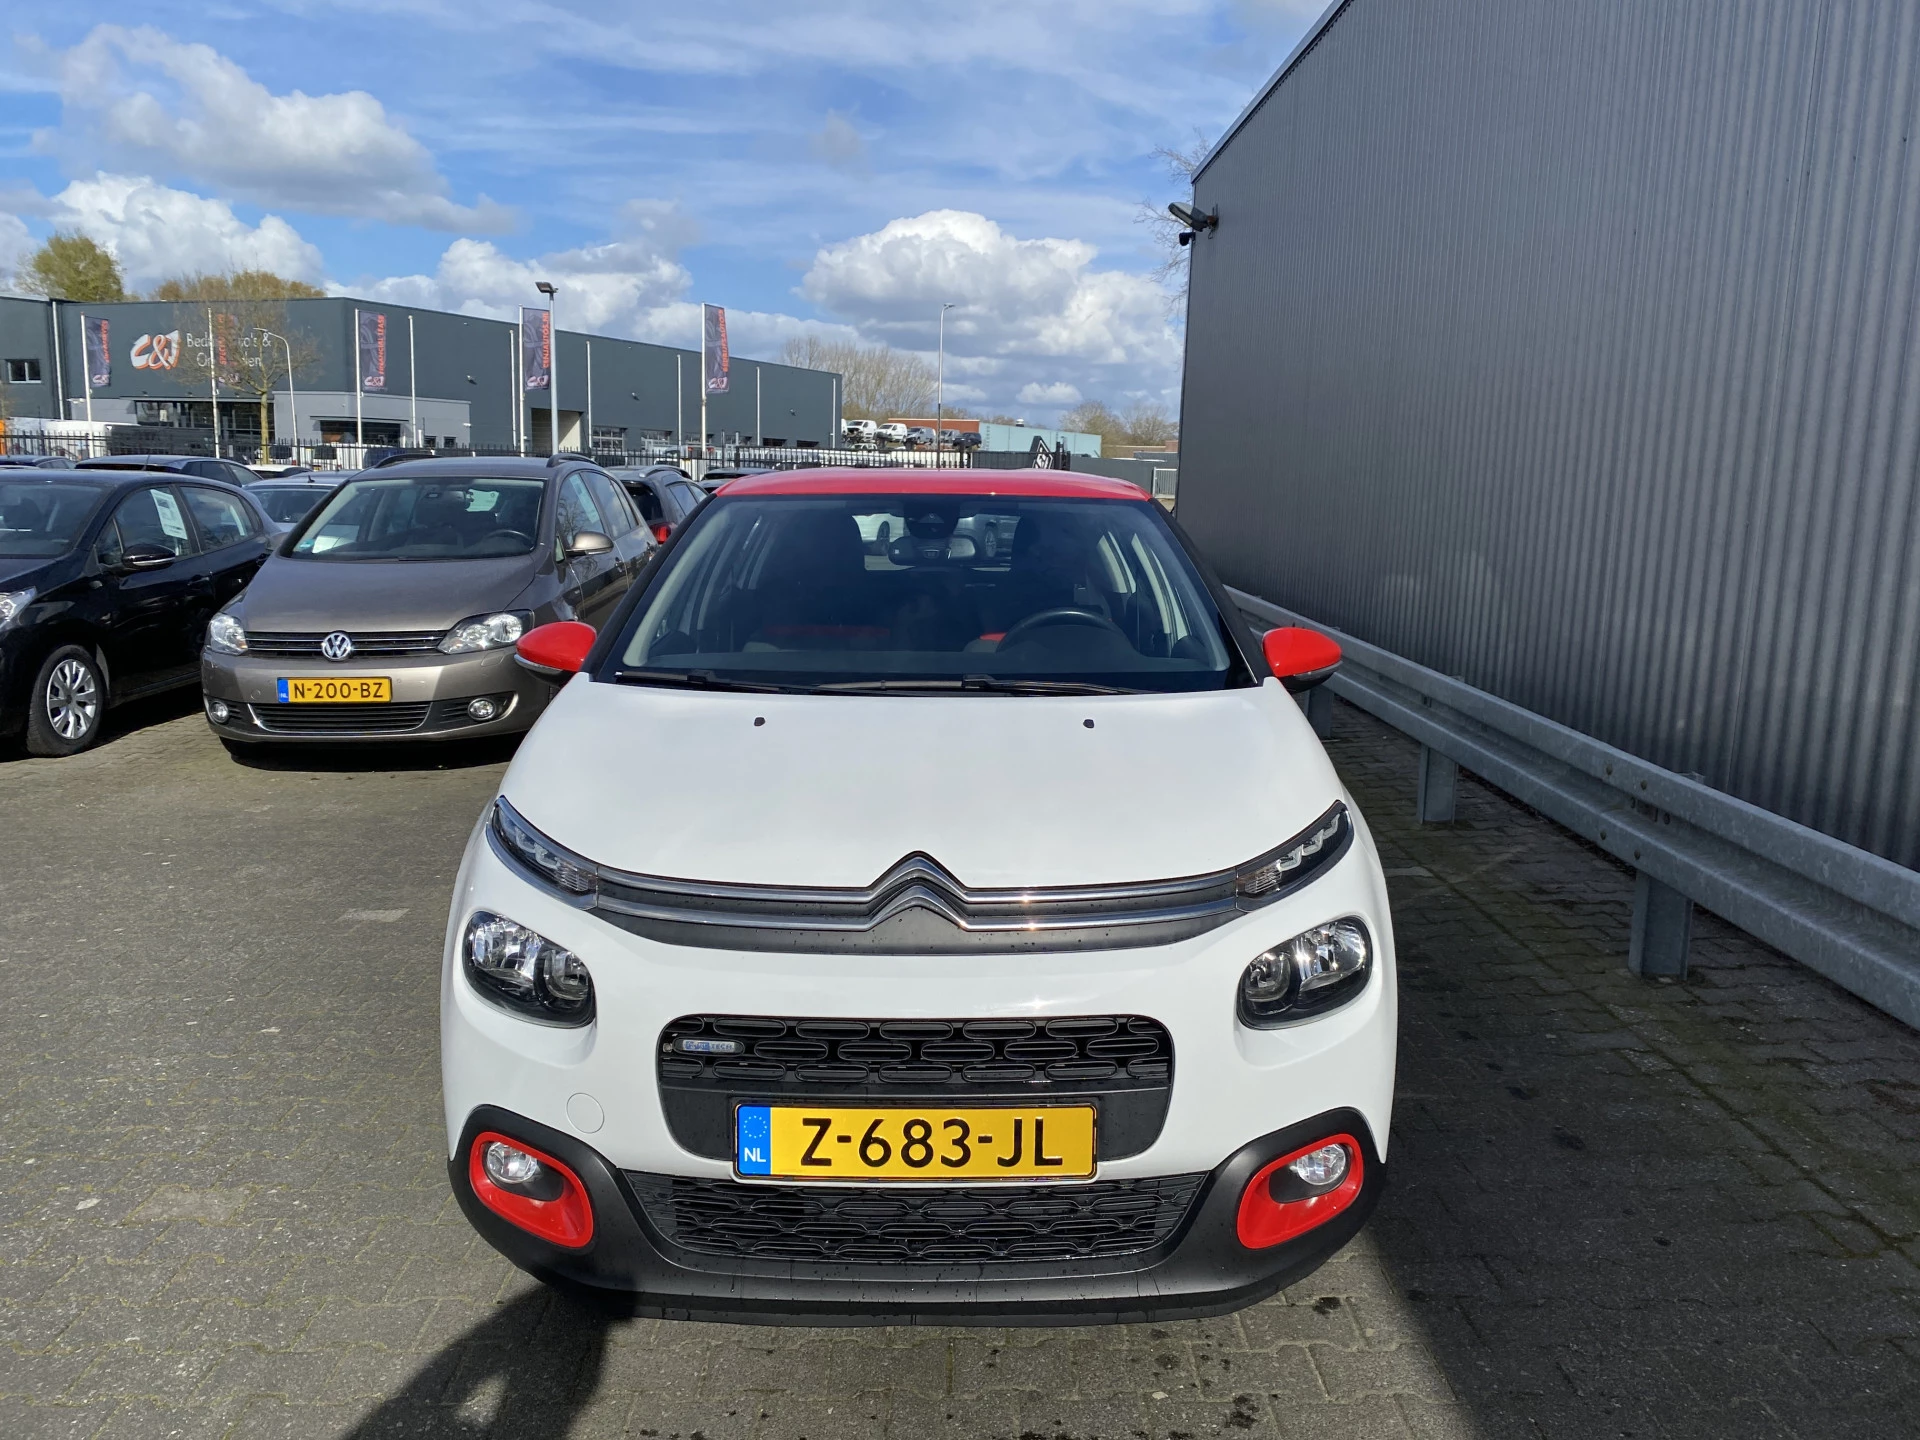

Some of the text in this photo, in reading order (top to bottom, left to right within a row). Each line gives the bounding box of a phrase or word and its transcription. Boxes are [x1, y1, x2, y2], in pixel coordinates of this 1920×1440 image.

[377, 314, 385, 375] FINANCIAL LEASE
[294, 682, 383, 698] N-200-BZ
[743, 1147, 767, 1163] NL
[800, 1117, 1063, 1168] Z-683-JL
